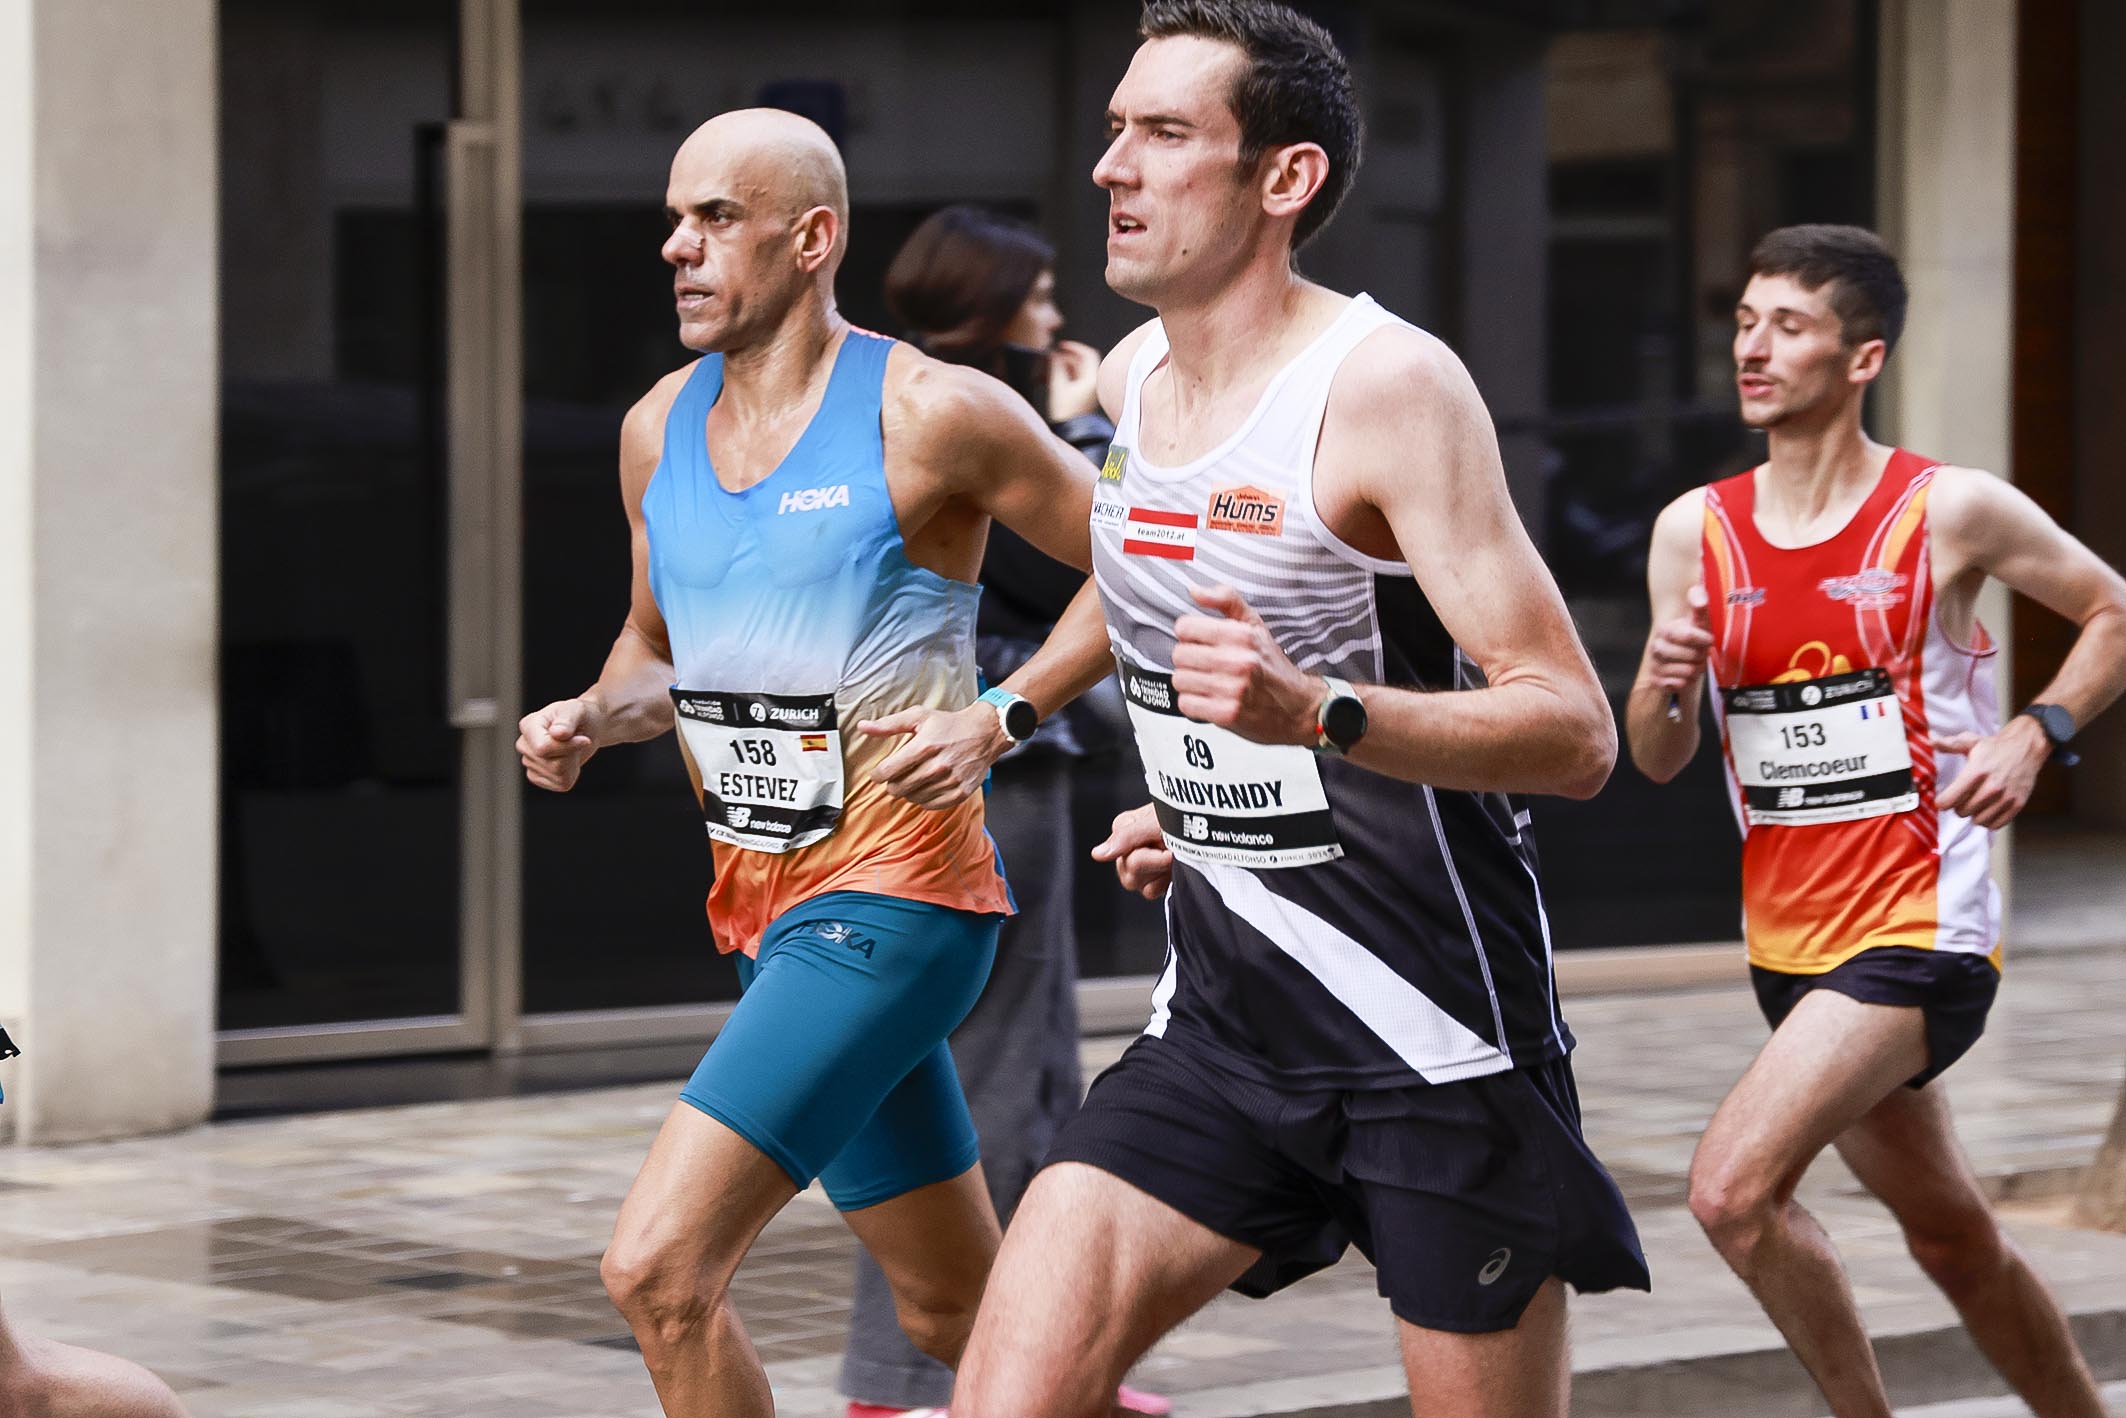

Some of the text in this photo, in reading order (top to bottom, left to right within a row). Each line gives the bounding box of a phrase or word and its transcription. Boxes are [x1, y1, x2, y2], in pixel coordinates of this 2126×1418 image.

[777, 484, 850, 515] HOKA
[1212, 493, 1278, 522] Hums
[769, 707, 819, 721] ZURICH
[1780, 722, 1826, 749] 153
[729, 739, 777, 767] 158
[1183, 734, 1214, 770] 89
[1760, 753, 1868, 780] Clemcoeur
[720, 772, 799, 802] ESTEVEZ
[1158, 770, 1283, 809] CANDYANDY
[1211, 830, 1230, 843] new
[1230, 830, 1274, 845] balance
[797, 919, 877, 960] OKA
